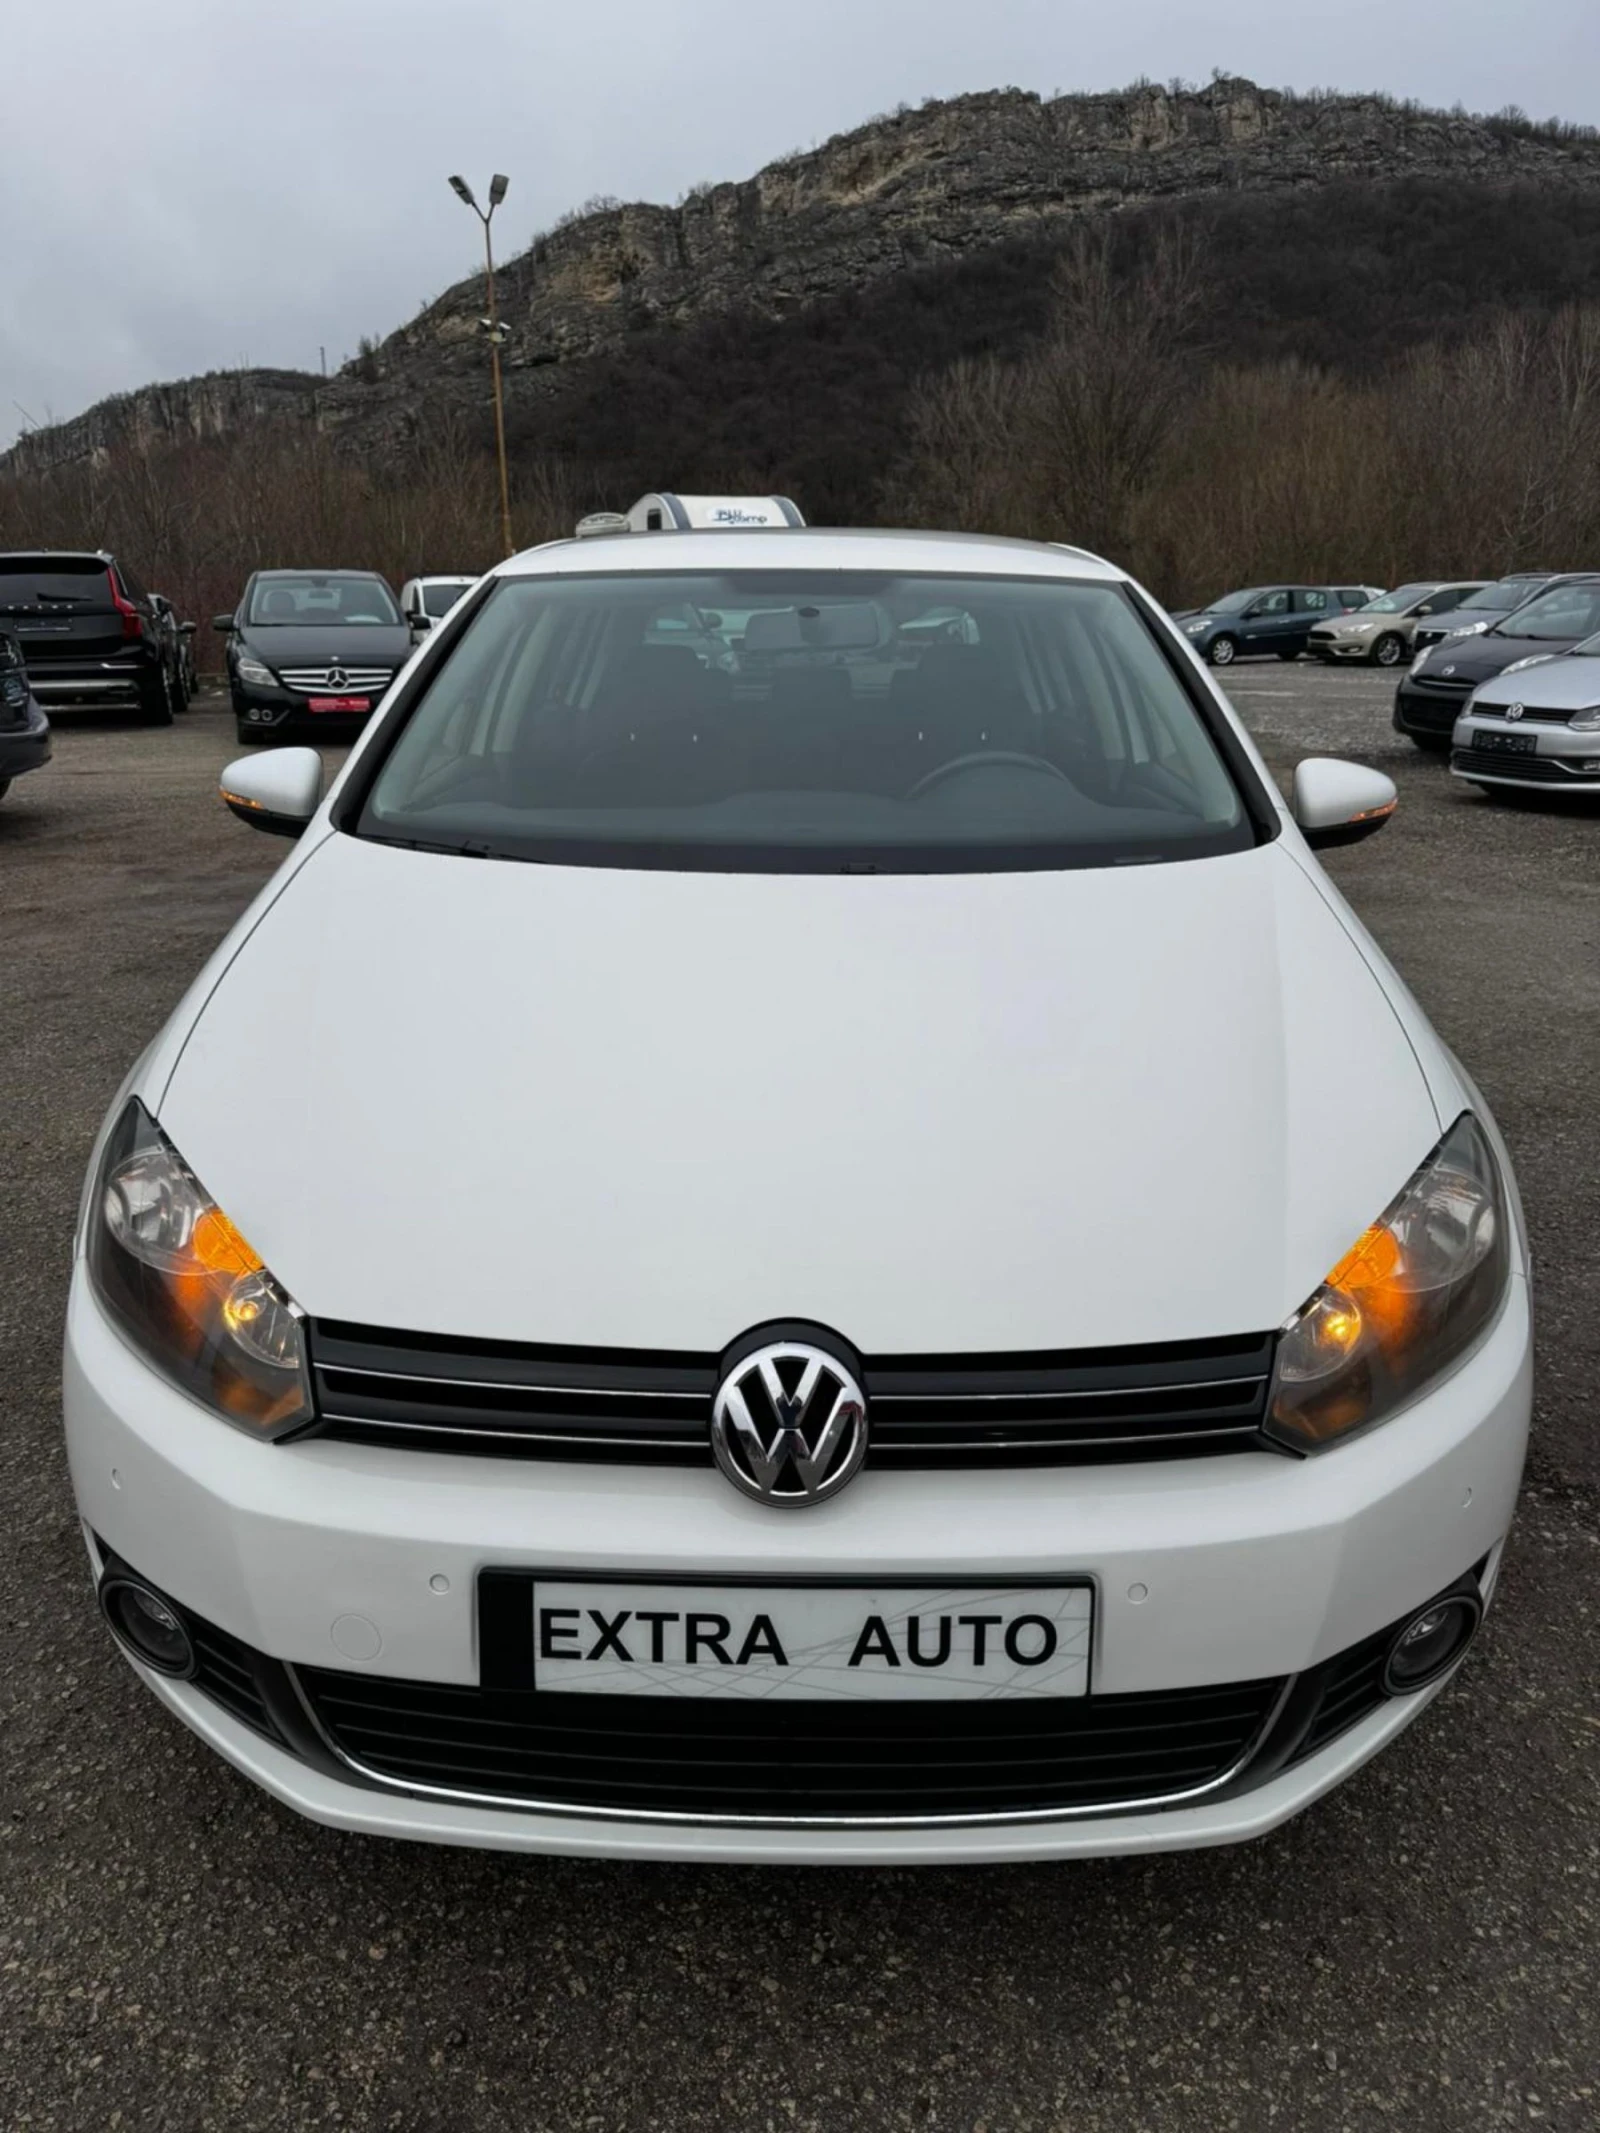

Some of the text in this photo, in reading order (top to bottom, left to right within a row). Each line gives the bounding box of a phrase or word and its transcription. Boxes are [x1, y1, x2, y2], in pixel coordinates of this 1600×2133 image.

[716, 1347, 863, 1502] VW
[540, 1608, 1057, 1667] EXTRA AUTO
